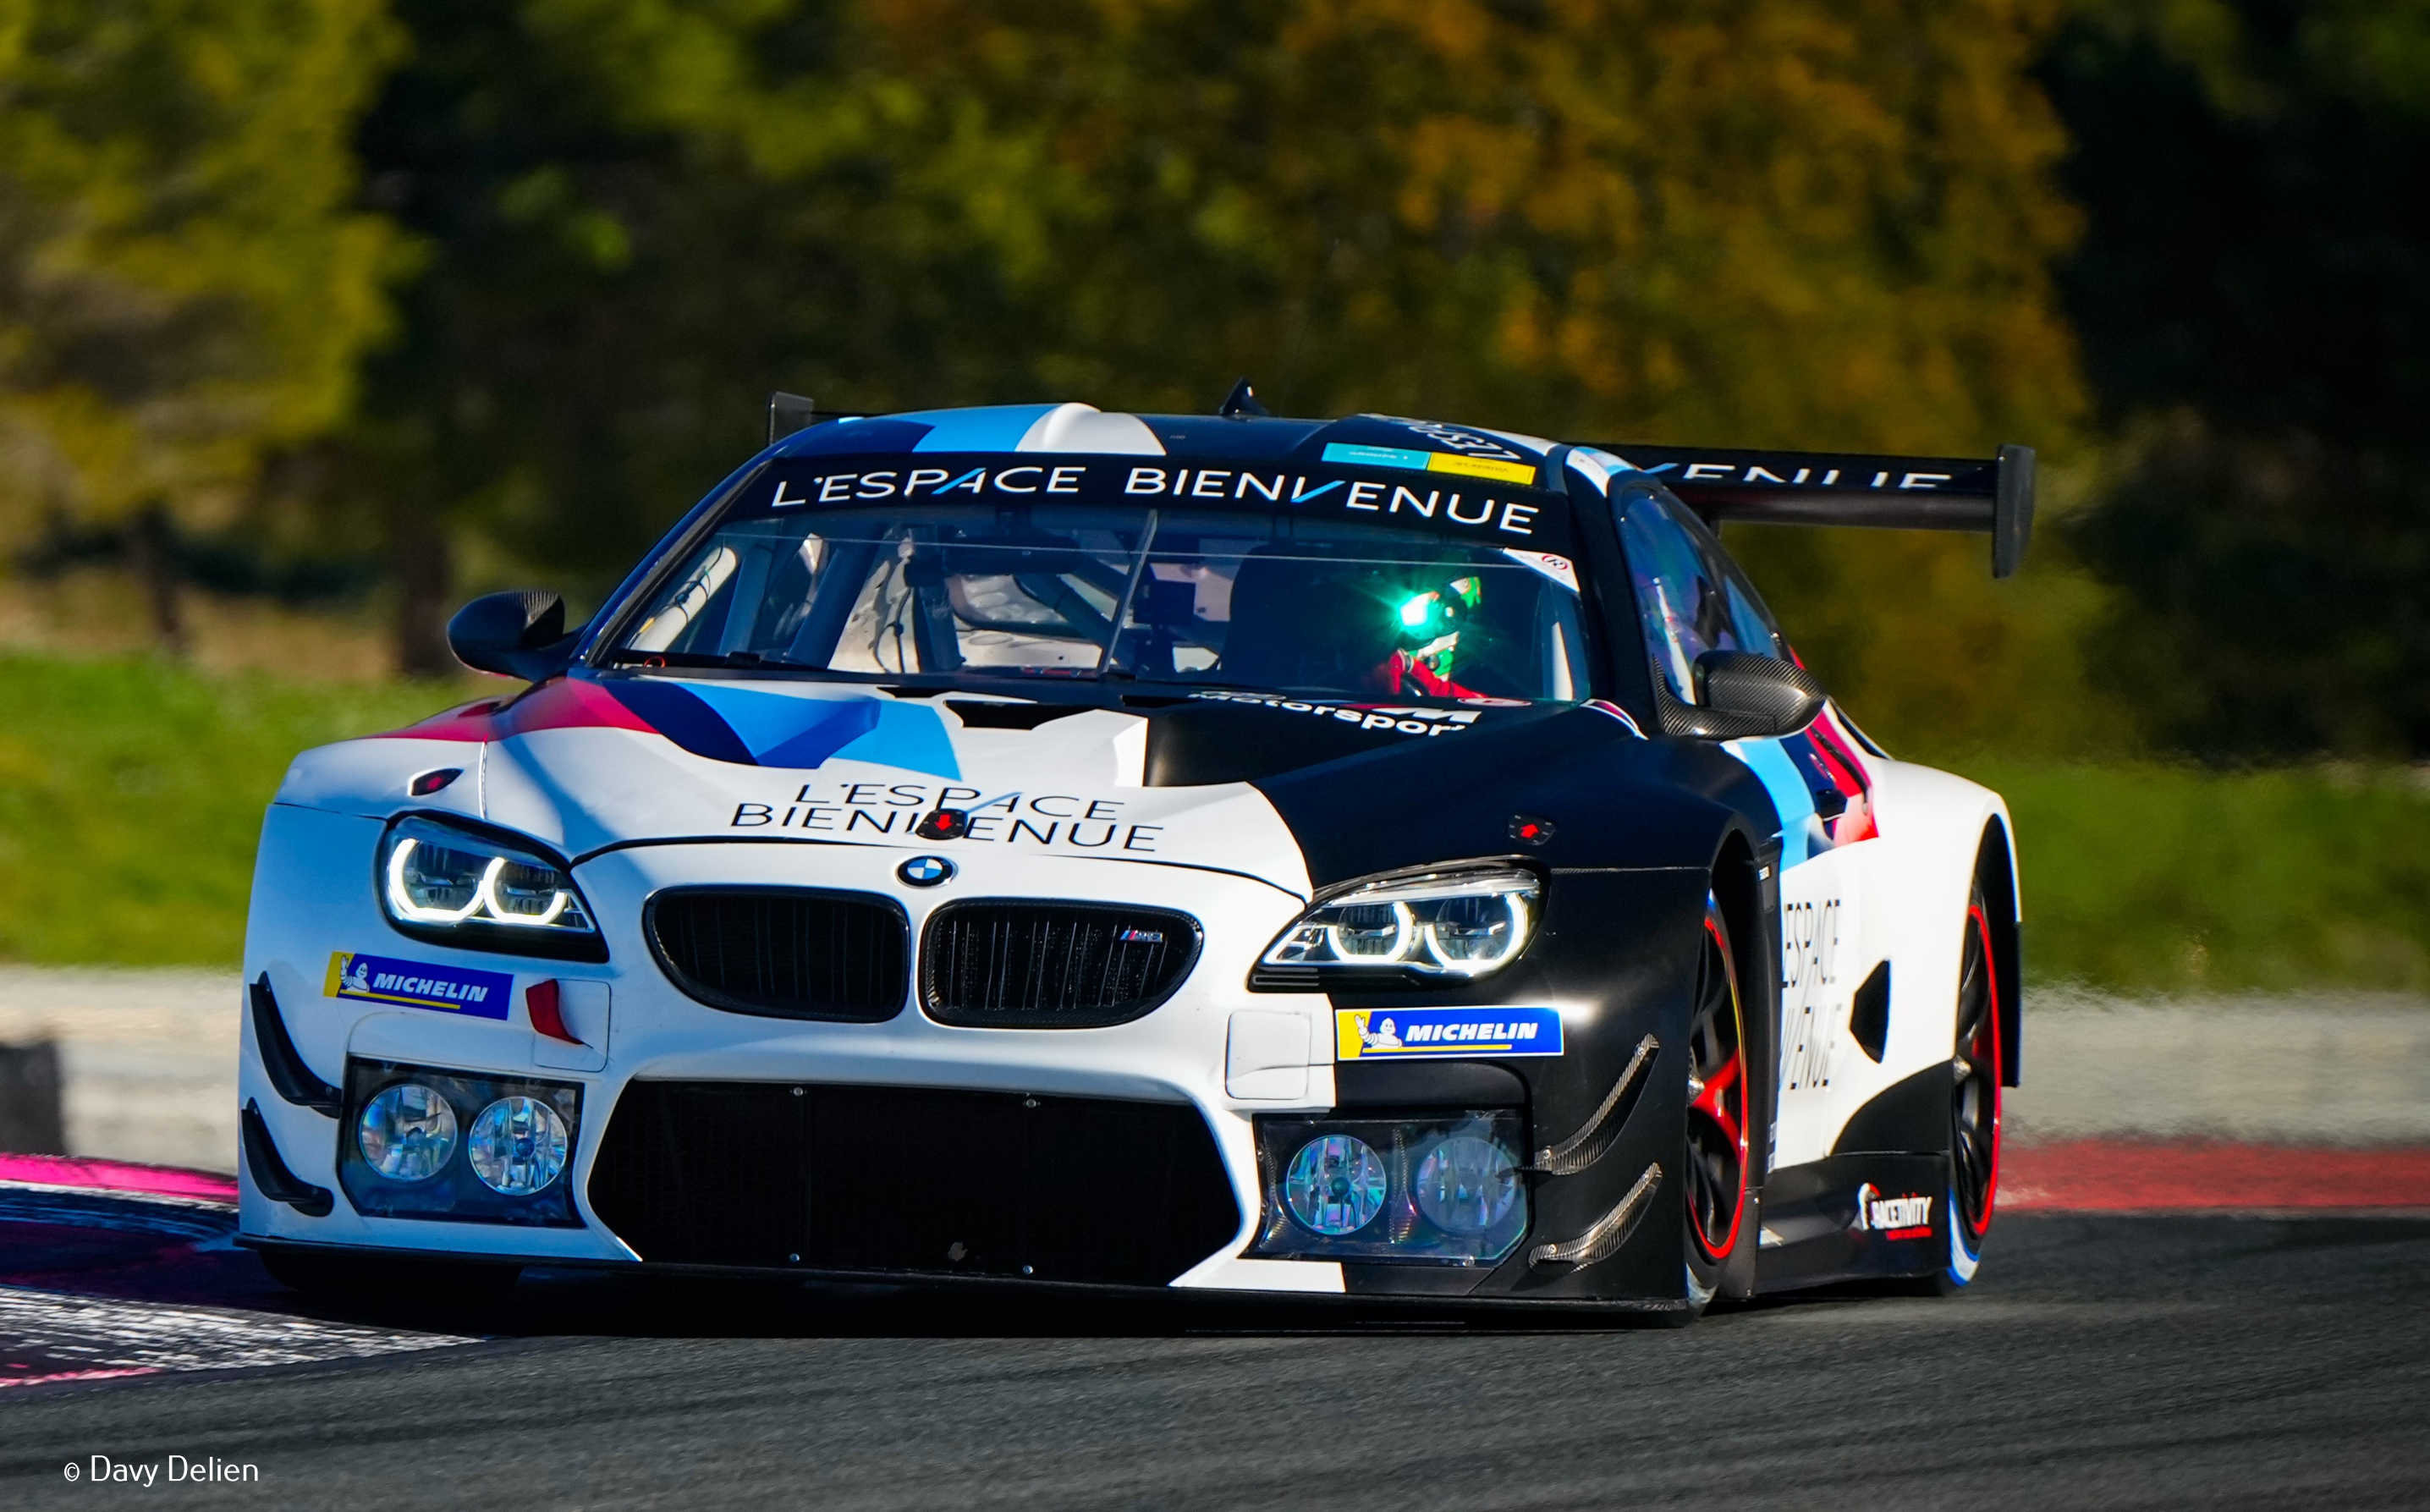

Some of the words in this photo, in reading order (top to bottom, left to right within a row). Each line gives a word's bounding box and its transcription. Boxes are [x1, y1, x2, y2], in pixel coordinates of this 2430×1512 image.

[771, 466, 1087, 508] L'ESPACE
[1124, 467, 1540, 535] BIENVENUE
[794, 783, 1125, 821] L'ESPACE
[372, 972, 489, 1003] MICHELIN
[1405, 1022, 1539, 1042] MICHELIN
